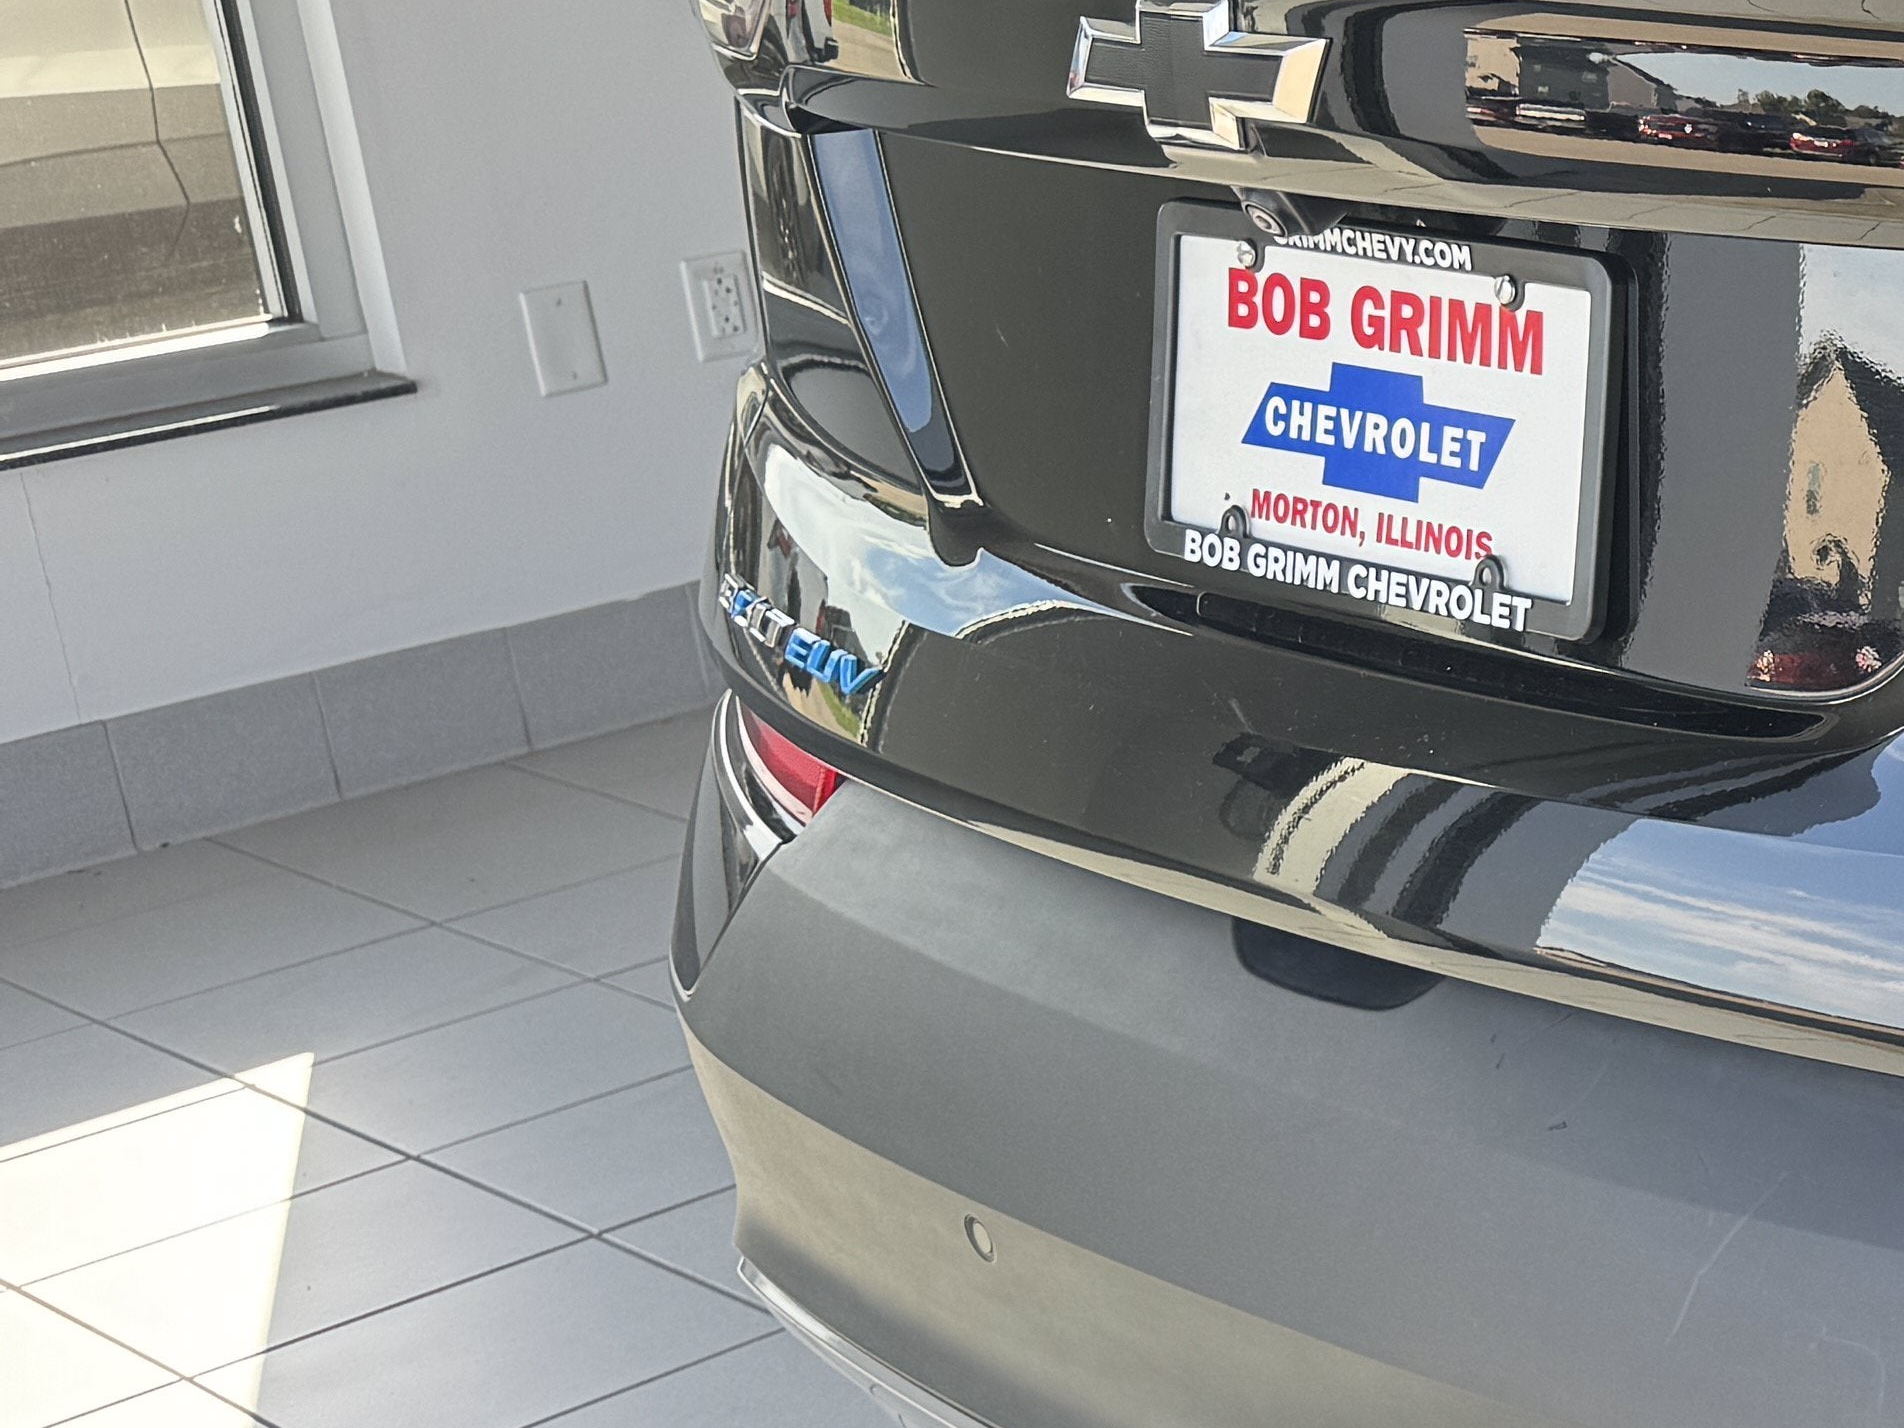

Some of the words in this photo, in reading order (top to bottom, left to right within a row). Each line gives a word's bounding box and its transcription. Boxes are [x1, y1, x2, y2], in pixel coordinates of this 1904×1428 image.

[1228, 268, 1331, 340] BOB
[1351, 285, 1544, 375] GRIMM
[1264, 396, 1487, 471] CHEVROLET
[1250, 488, 1366, 547] MORTON,
[1376, 513, 1493, 560] ILLINOIS
[1184, 529, 1241, 570] BOB
[1247, 553, 1340, 593] GRIMM
[1347, 564, 1533, 632] CHEVROLET
[784, 626, 884, 695] EUV
